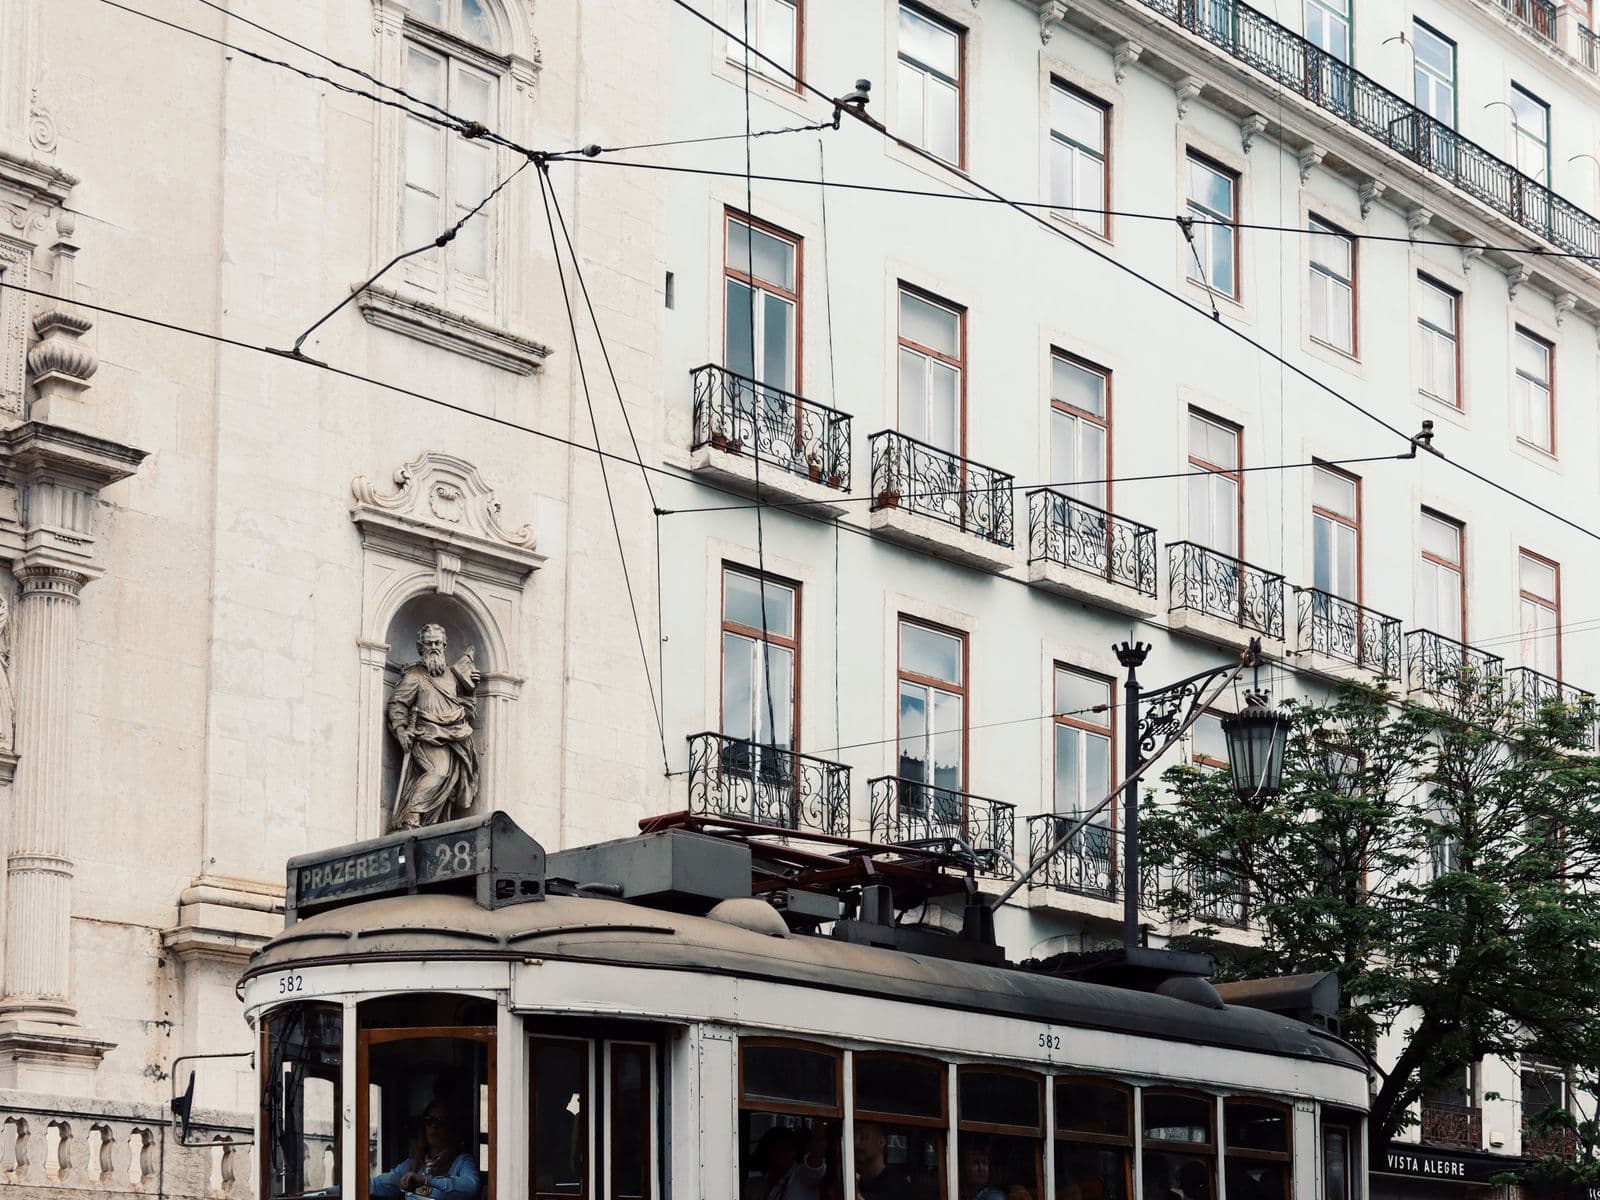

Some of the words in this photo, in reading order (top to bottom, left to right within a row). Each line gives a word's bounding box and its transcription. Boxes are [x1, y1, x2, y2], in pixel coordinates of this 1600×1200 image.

[434, 840, 472, 876] 28
[301, 850, 392, 892] PRAZERES
[279, 975, 303, 994] 582
[1038, 1033, 1060, 1050] 582
[1387, 1154, 1419, 1172] VISTA
[1423, 1159, 1465, 1176] ALEGRE
